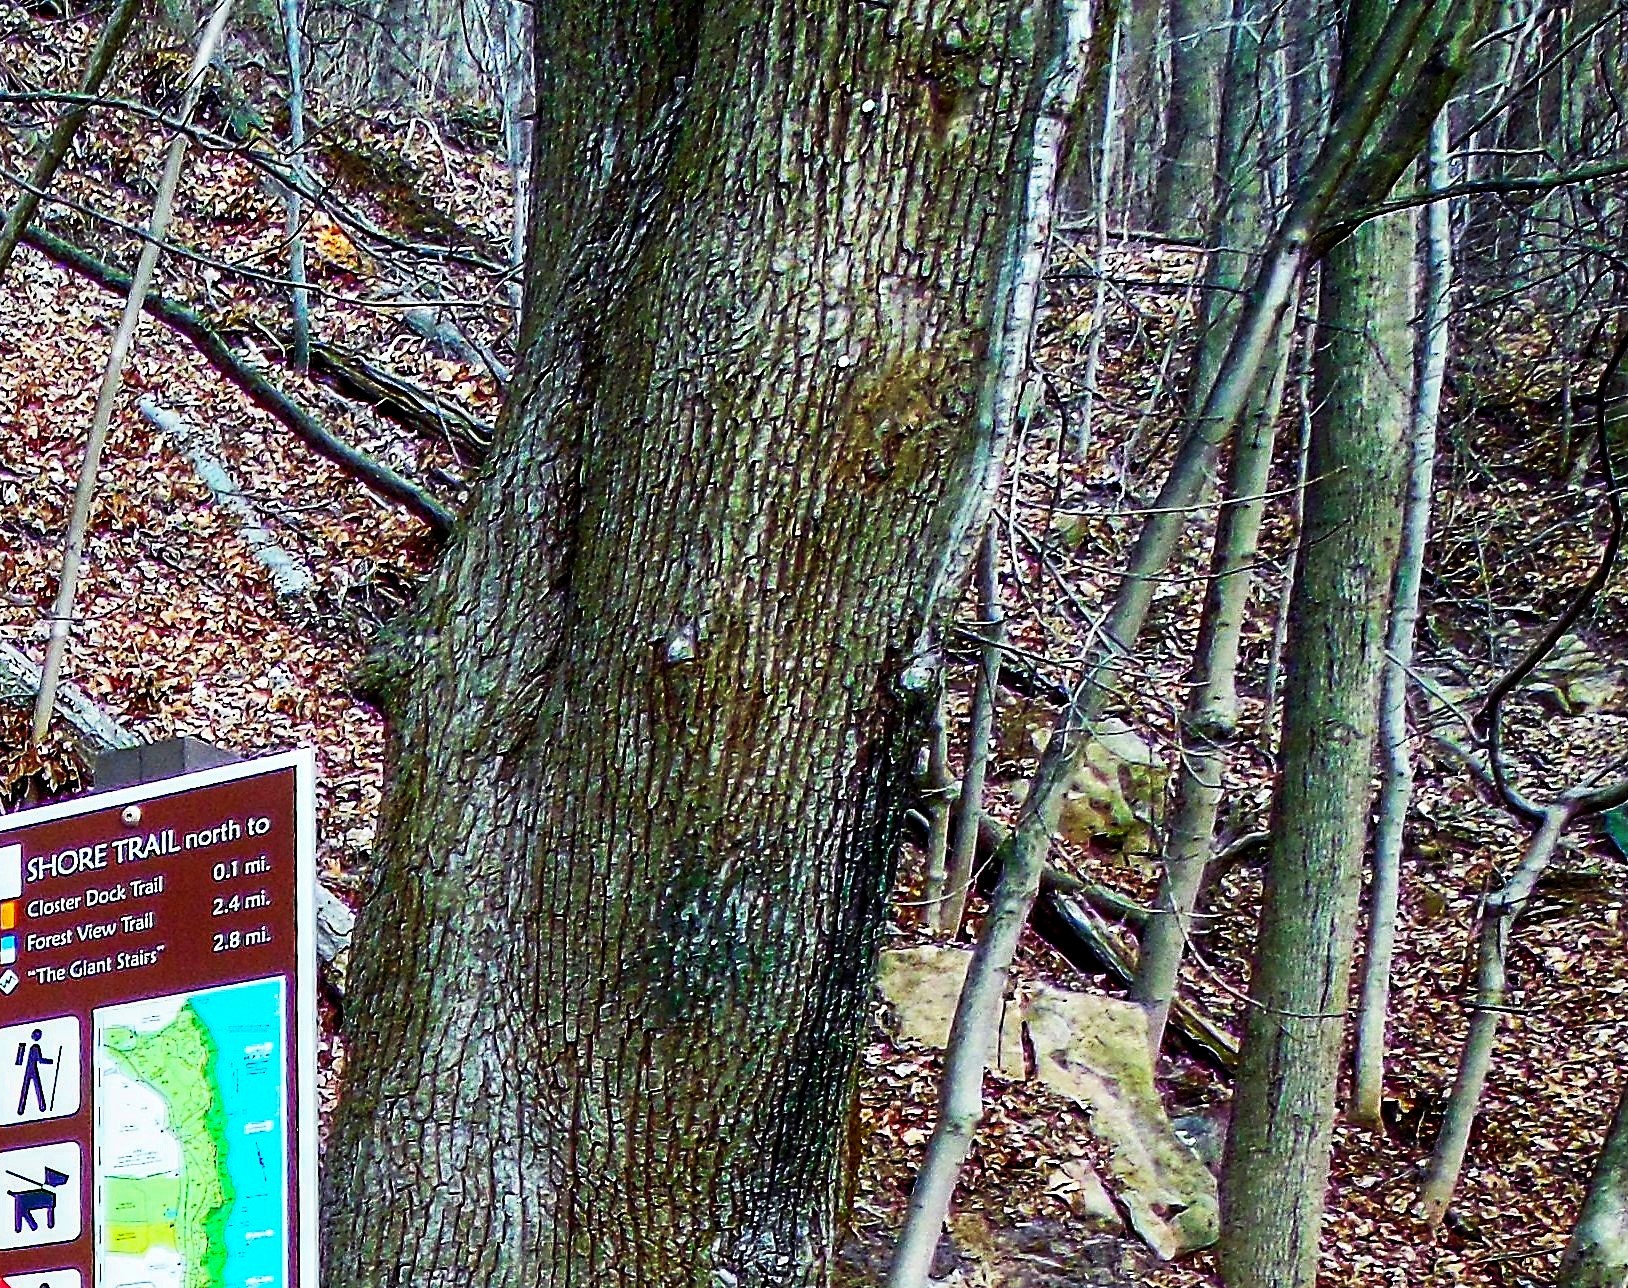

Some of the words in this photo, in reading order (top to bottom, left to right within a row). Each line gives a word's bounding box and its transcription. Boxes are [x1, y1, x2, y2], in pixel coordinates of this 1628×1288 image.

[27, 843, 107, 882] SHORE
[112, 829, 181, 863] TRAIL
[185, 820, 241, 849] north
[247, 817, 270, 836] to
[213, 861, 238, 881] 0.1
[245, 855, 271, 875] mi.
[27, 897, 81, 918] Closter
[86, 884, 126, 906] Dock
[130, 876, 163, 897] Trail
[212, 895, 240, 916] 2.4
[245, 890, 271, 909] mi.
[28, 930, 72, 952] Forest
[77, 922, 117, 942] View
[121, 912, 154, 933] Trail
[213, 931, 240, 951] 2.8
[245, 926, 271, 946] mi.
[70, 956, 111, 978] Giant
